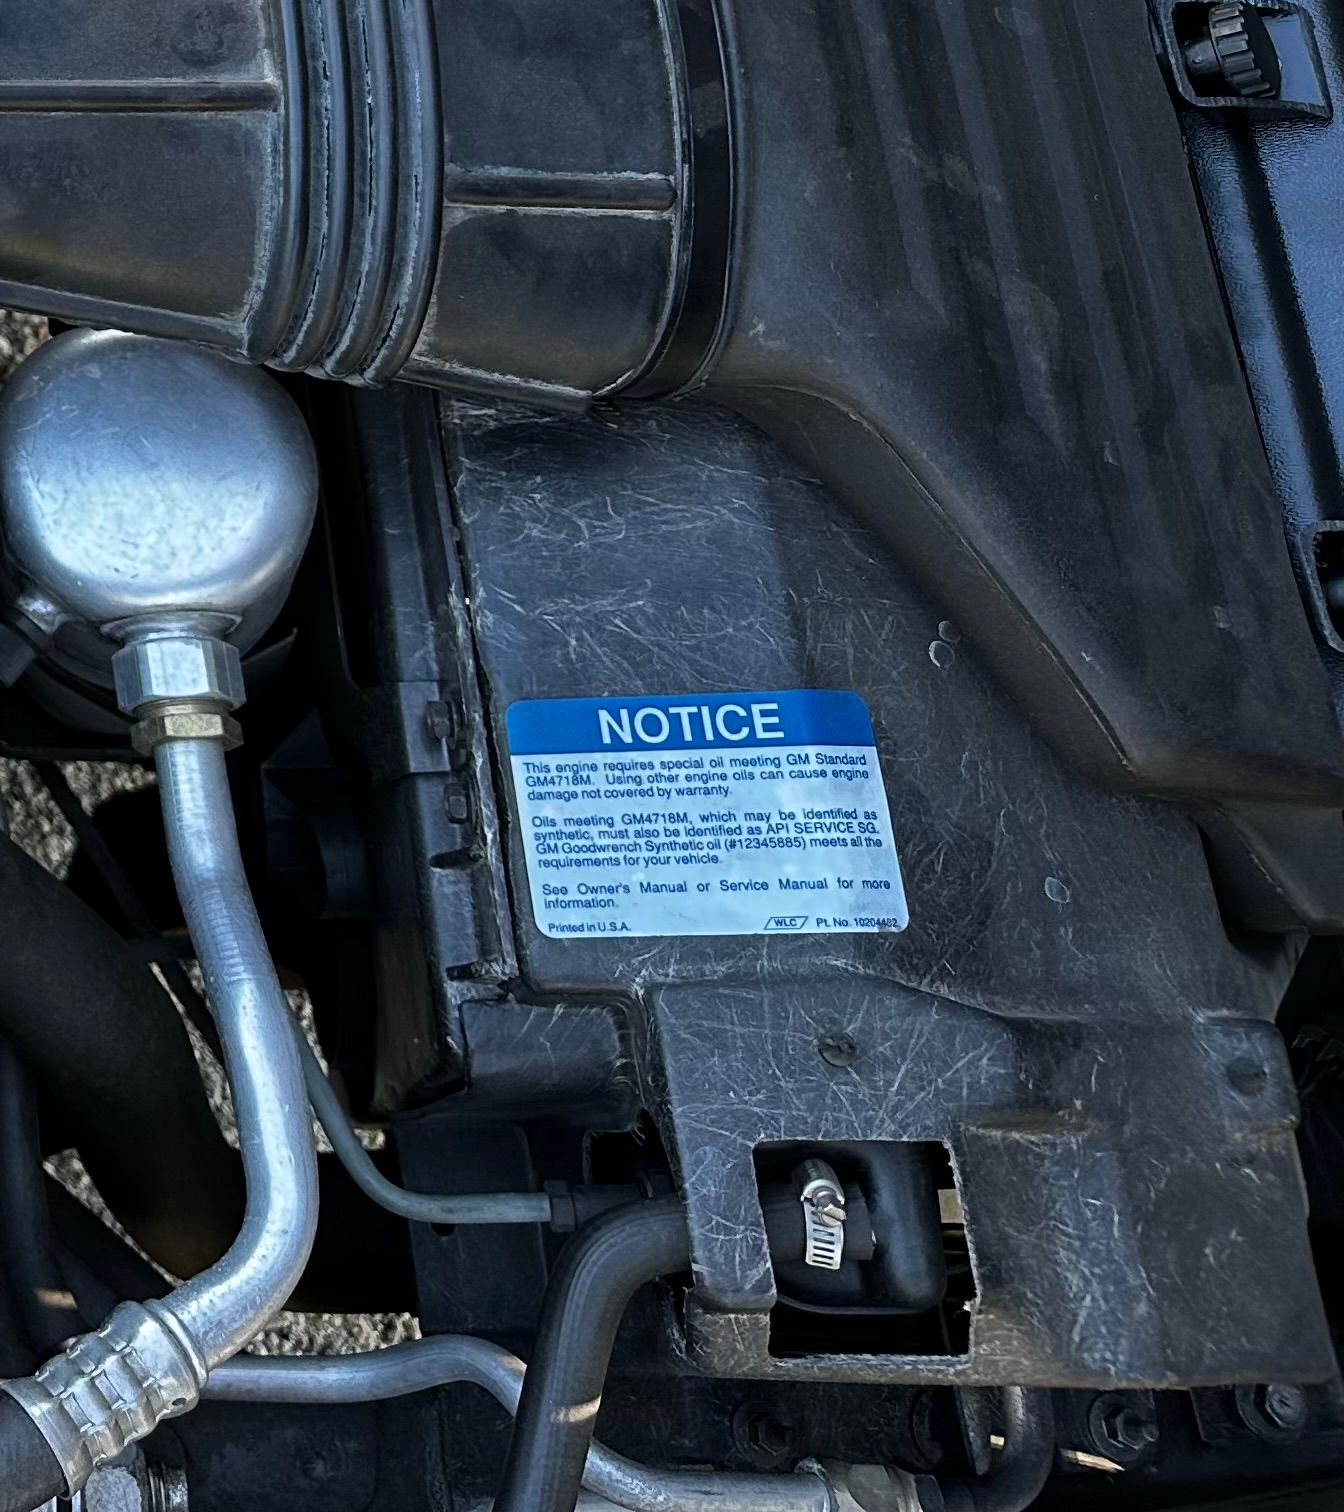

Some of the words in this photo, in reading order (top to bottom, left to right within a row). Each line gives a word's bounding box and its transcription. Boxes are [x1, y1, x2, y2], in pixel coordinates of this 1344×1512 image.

[598, 702, 784, 745] NOTICE
[522, 762, 550, 776] This
[555, 761, 598, 775] engine
[602, 759, 655, 773] requires
[659, 756, 704, 772] special
[708, 756, 724, 768] oil
[729, 754, 781, 768] meeting
[785, 752, 810, 765] GM
[814, 752, 866, 765] Standard
[525, 774, 594, 787] GM4718M.
[605, 772, 642, 786] Using
[646, 771, 679, 784] other
[684, 770, 727, 784] engine
[732, 769, 755, 781] oils
[759, 770, 784, 780] can
[788, 768, 827, 778] cause
[831, 767, 869, 779] engine
[527, 789, 578, 802] damage
[580, 787, 602, 799] not
[603, 785, 654, 798] covered
[655, 785, 672, 799] by
[674, 783, 731, 797] warranty.
[531, 815, 557, 827] Oils
[563, 814, 614, 828] meeting
[620, 811, 692, 825] GM4718M,
[698, 810, 736, 825] which
[743, 811, 771, 824] may
[775, 808, 800, 823] be
[802, 807, 858, 823] identified
[863, 810, 878, 820] as
[533, 828, 593, 843] synthetic,
[597, 827, 630, 839] must
[633, 826, 660, 838] also
[662, 826, 680, 837] be
[683, 824, 742, 837] identified
[746, 825, 762, 835] as
[765, 822, 789, 835] API
[793, 821, 855, 834] SERVICE
[535, 842, 559, 854] GM
[561, 840, 642, 854] Goodwrench
[644, 839, 704, 854] Synthetic
[706, 838, 721, 850] oil
[809, 837, 847, 848] meets
[850, 836, 863, 848] all
[864, 836, 882, 848] the
[537, 855, 621, 870] requirements
[622, 854, 640, 865] for
[642, 855, 671, 868] your
[541, 883, 568, 895] See
[576, 882, 630, 895] Owner's
[639, 880, 687, 893] Manual
[696, 882, 710, 892] or
[719, 878, 769, 891] Service
[777, 877, 828, 890] Manual
[836, 876, 853, 889] for
[861, 879, 890, 889] more
[543, 896, 617, 909] information.
[547, 922, 584, 932] Printed
[586, 922, 596, 931] in
[597, 921, 631, 932] U.S.A.
[774, 917, 797, 927] WLC
[833, 918, 852, 927] No.
